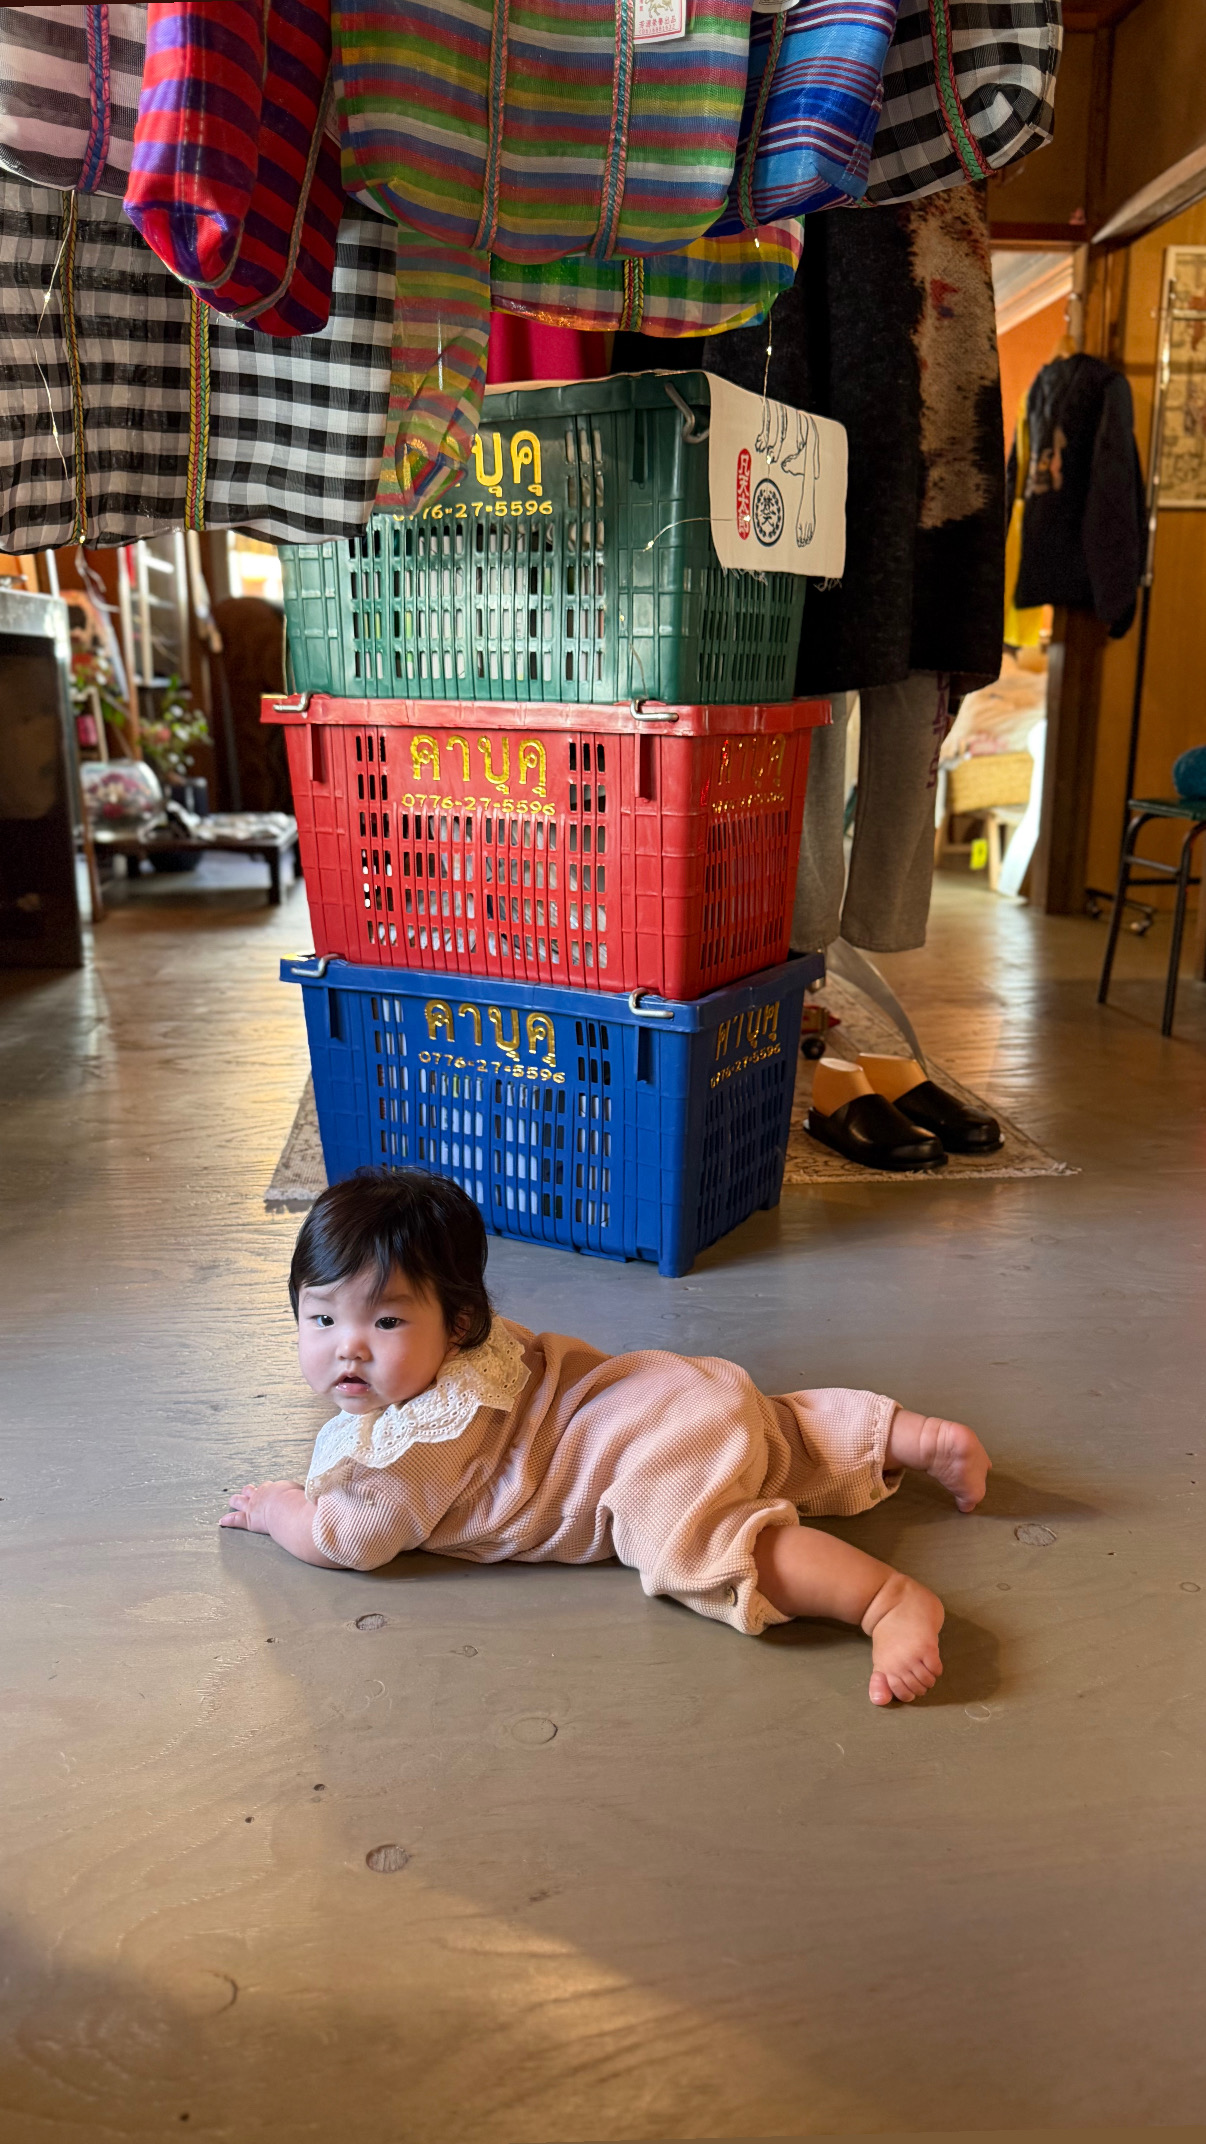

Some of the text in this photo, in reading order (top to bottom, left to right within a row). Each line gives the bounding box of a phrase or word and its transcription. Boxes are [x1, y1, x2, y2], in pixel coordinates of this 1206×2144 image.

[471, 430, 543, 497] บุคุ
[402, 793, 556, 816] 0776-27-5596
[418, 1050, 567, 1084] 0776-27-5596
